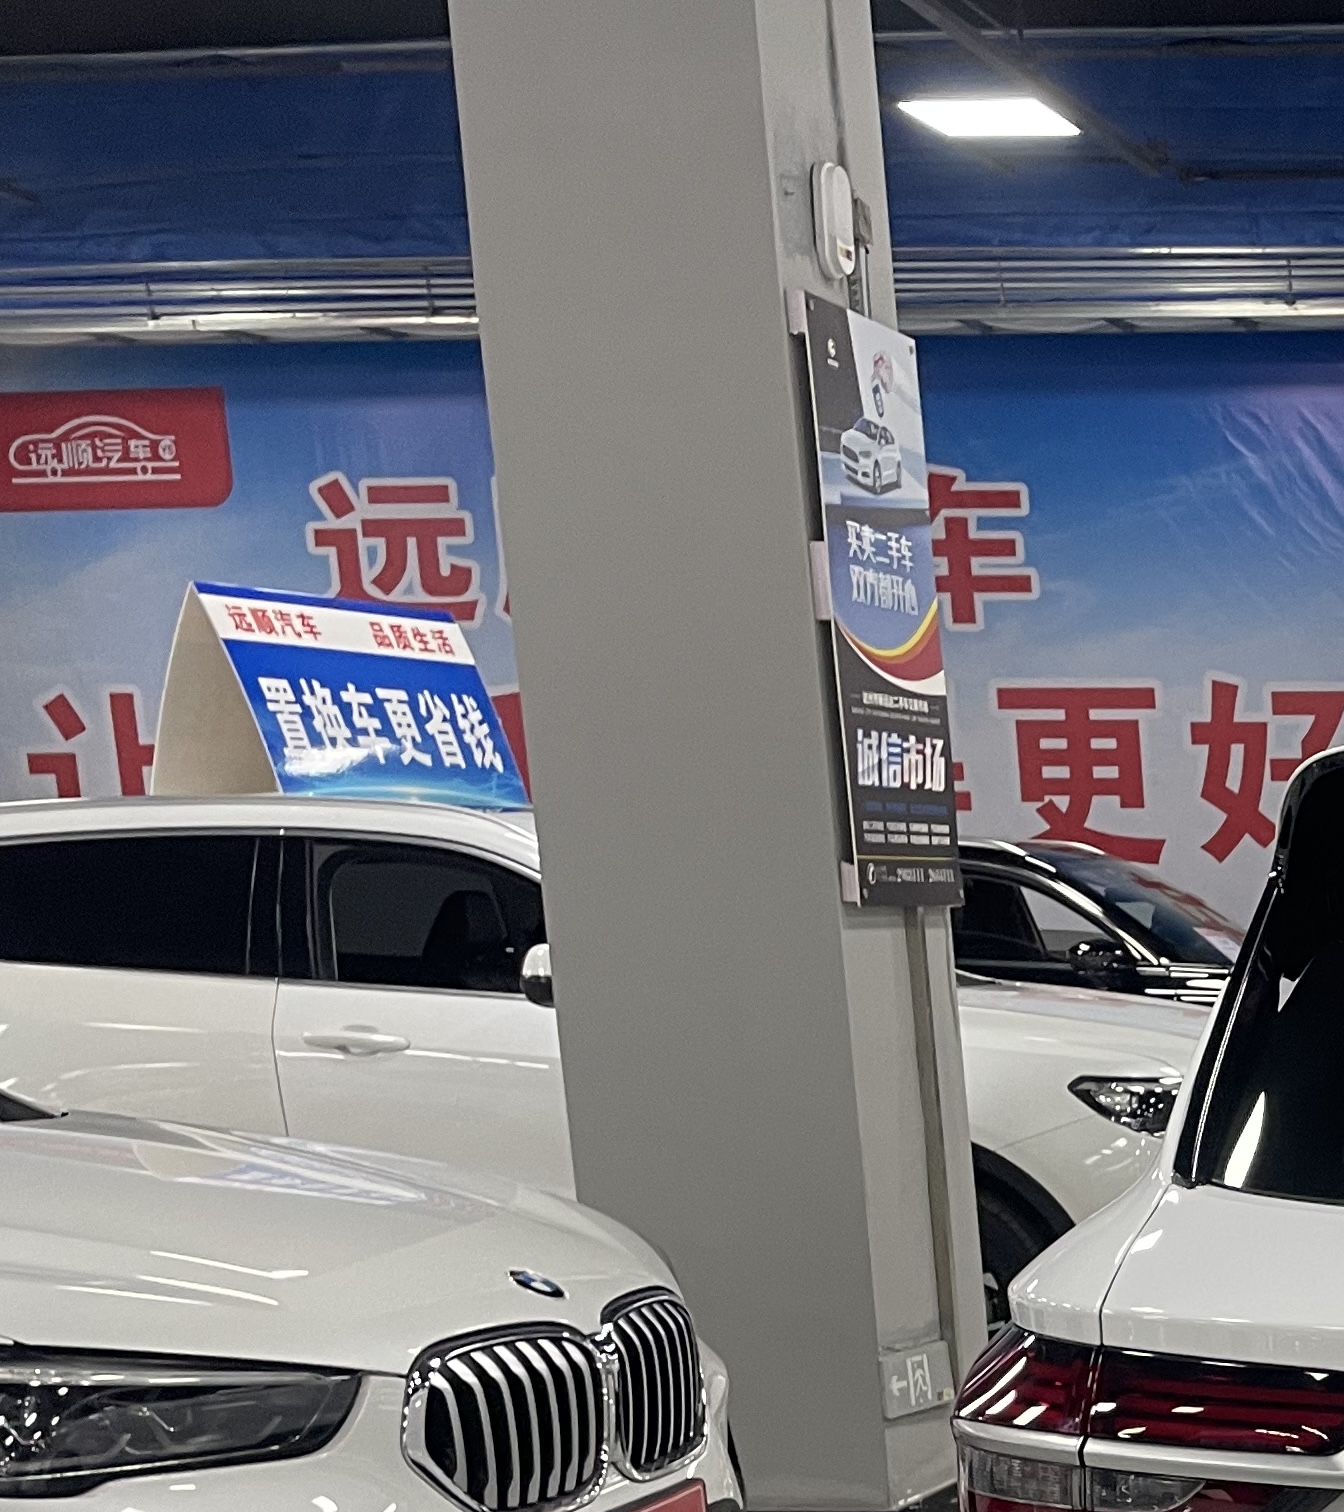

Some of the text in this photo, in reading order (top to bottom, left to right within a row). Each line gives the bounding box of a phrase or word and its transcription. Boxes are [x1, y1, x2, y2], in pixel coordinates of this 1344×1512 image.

[28, 437, 152, 470] 远顺汽车
[312, 477, 482, 622] 远
[846, 520, 914, 573] 买卖二手车
[225, 603, 456, 656] 远顺汽车 品质生活
[257, 677, 505, 774] 置换车更省钱
[856, 728, 946, 792] 诚信市场
